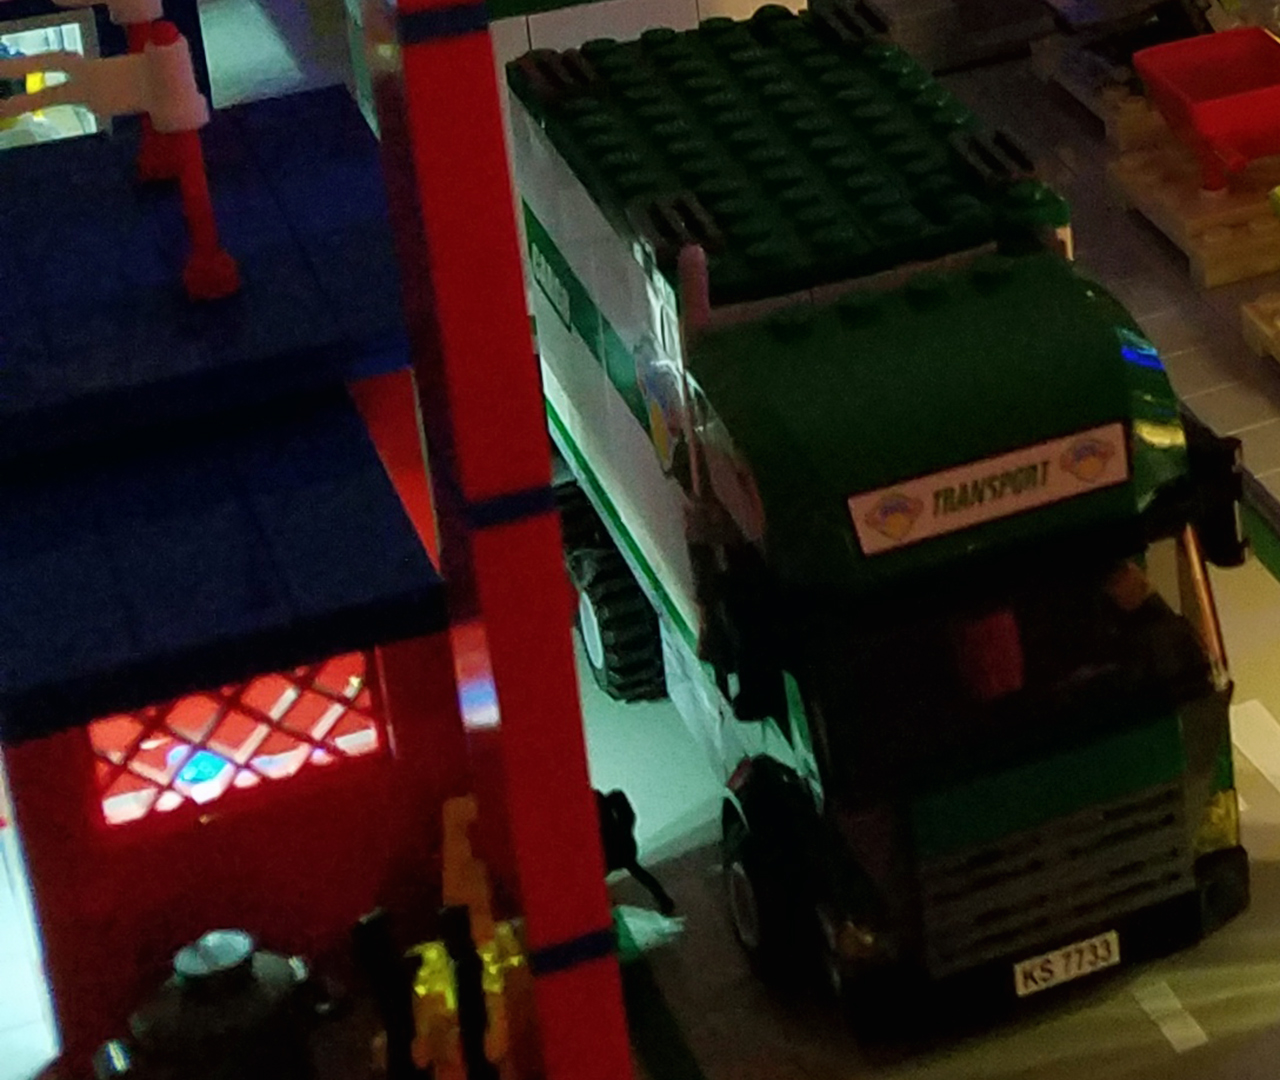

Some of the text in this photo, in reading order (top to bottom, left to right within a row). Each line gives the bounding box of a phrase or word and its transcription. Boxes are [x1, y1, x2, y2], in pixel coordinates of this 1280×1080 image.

[933, 460, 1050, 516] TRANSPORT
[1022, 939, 1111, 989] KS 7733
